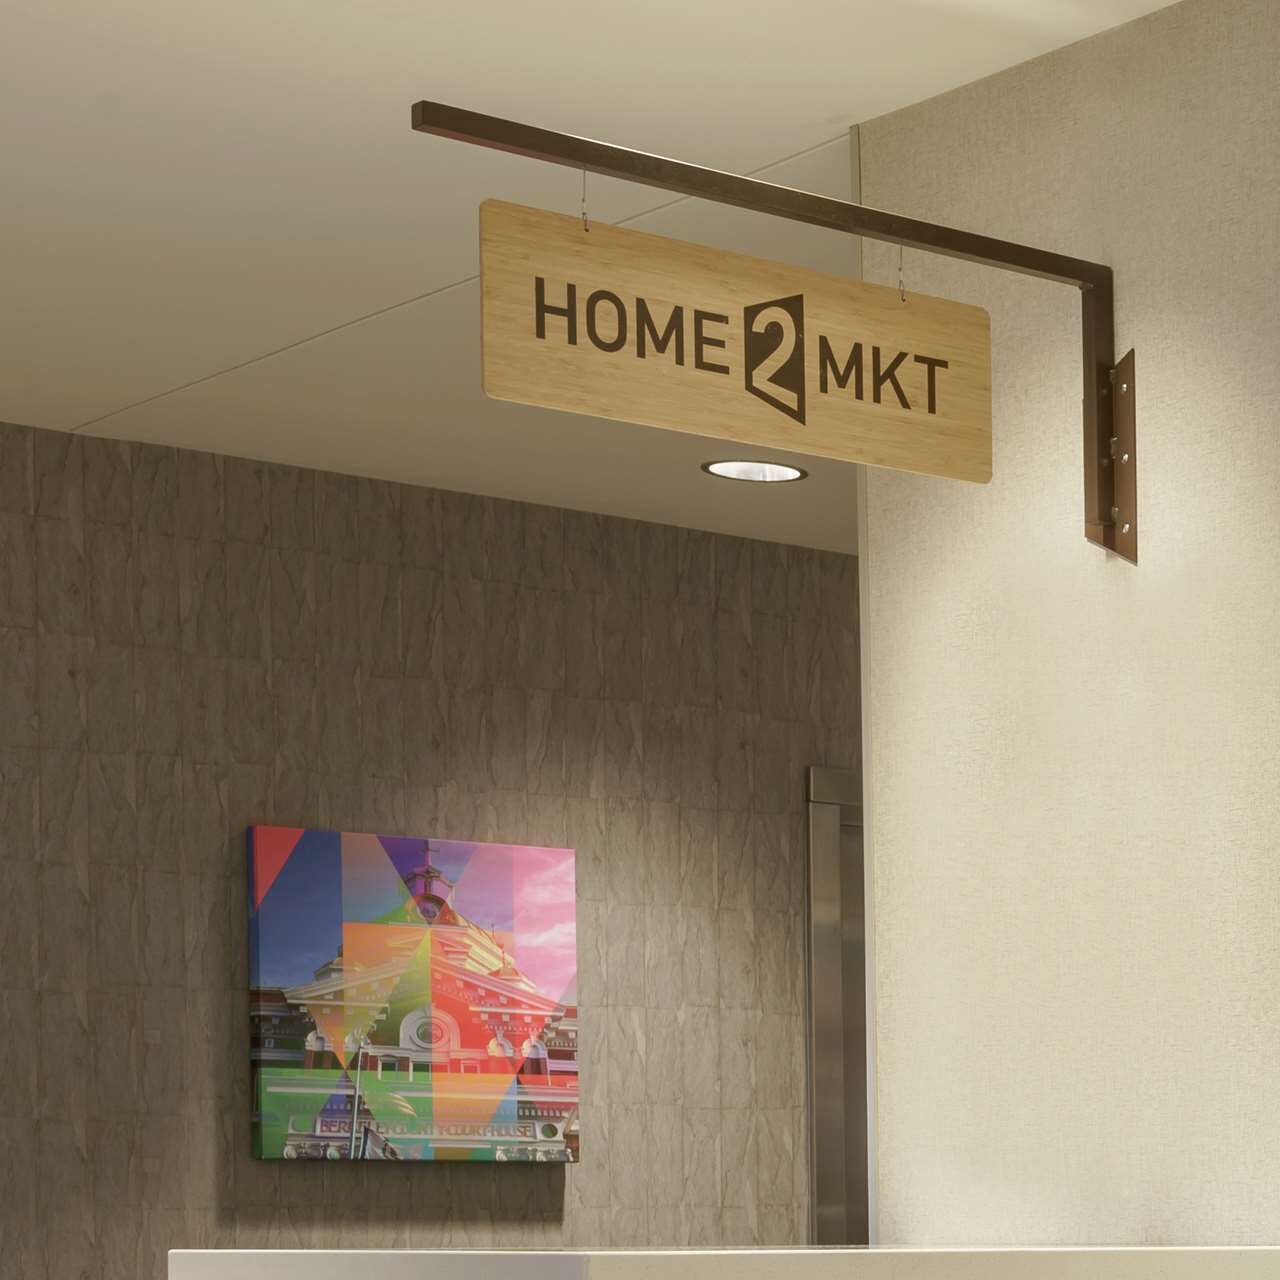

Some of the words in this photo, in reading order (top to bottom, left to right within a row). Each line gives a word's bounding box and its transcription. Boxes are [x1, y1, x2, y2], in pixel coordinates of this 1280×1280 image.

[535, 276, 730, 376] HOME
[747, 301, 803, 417] 2
[818, 335, 949, 415] MKT
